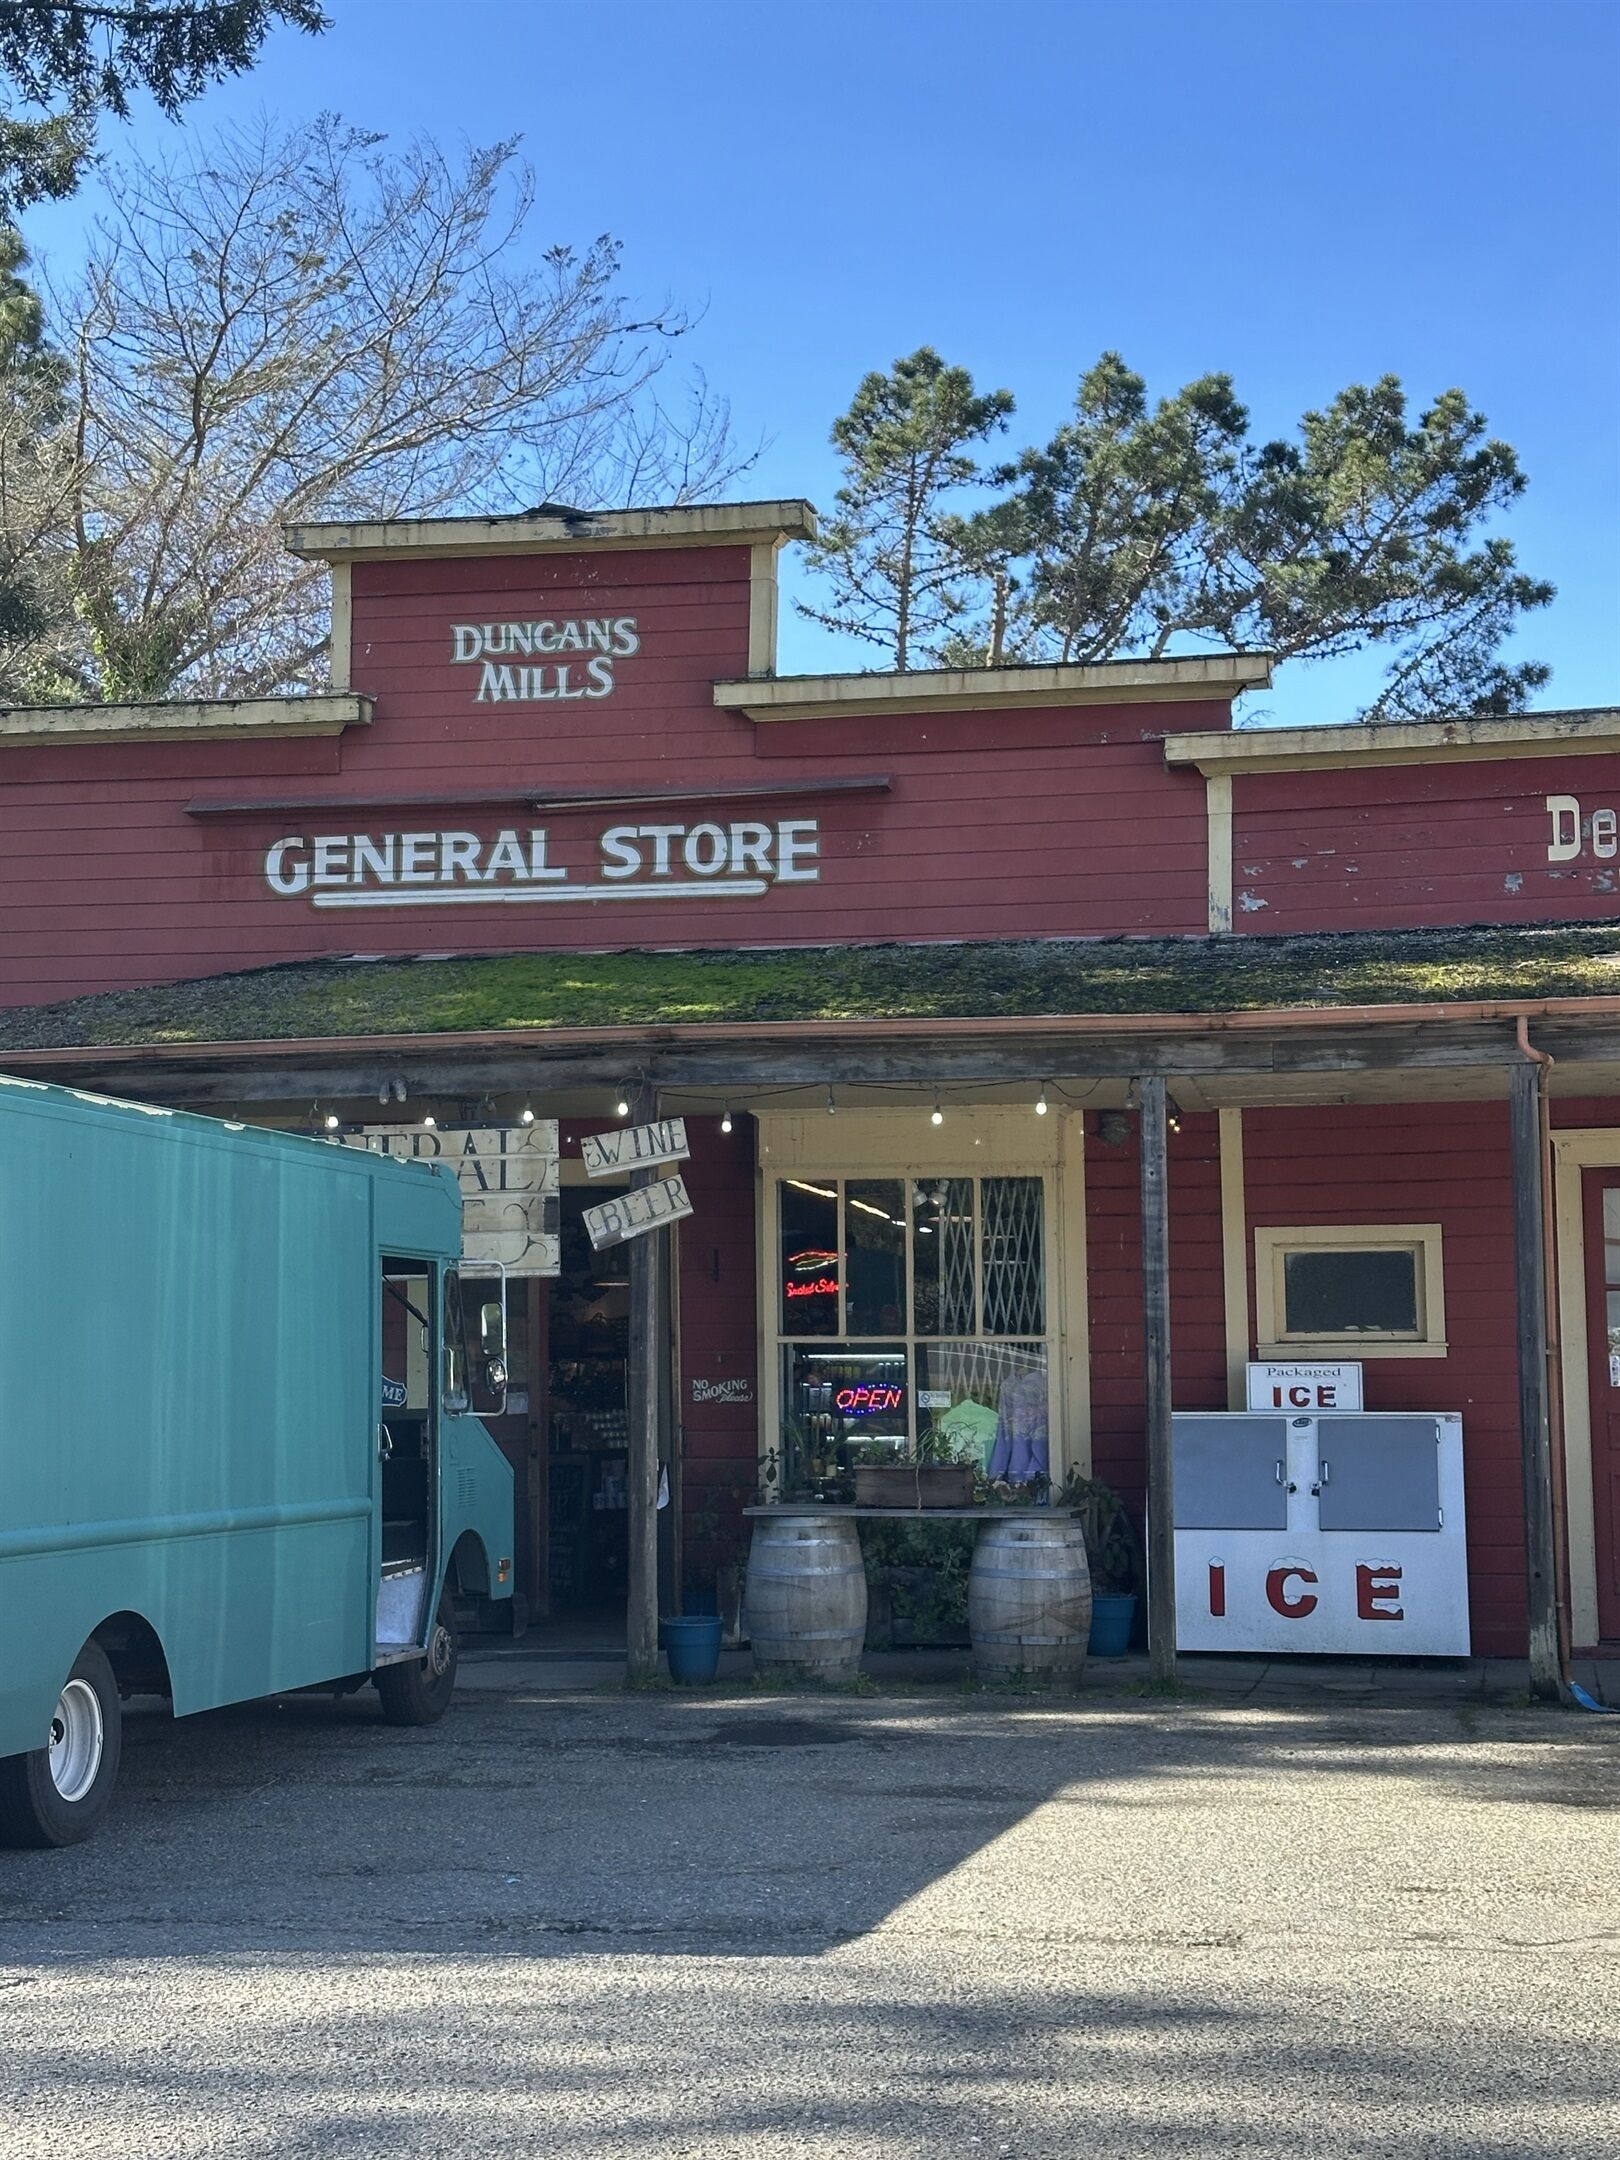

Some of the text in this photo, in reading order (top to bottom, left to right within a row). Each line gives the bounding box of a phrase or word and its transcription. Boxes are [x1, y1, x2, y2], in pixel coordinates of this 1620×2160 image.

[450, 616, 640, 664] DUNCANS
[473, 656, 616, 703] MILLS
[264, 819, 821, 896] GENERAL STORE
[592, 1118, 687, 1165] WINE
[597, 1178, 689, 1234] BEER
[692, 1379, 709, 1390] NO
[692, 1379, 748, 1402] SMOKING
[1266, 1367, 1342, 1379] Packaged
[716, 1391, 753, 1404] please
[835, 1388, 903, 1409] OPEN
[1271, 1383, 1337, 1408] ICE
[1207, 1556, 1405, 1621] ICE
